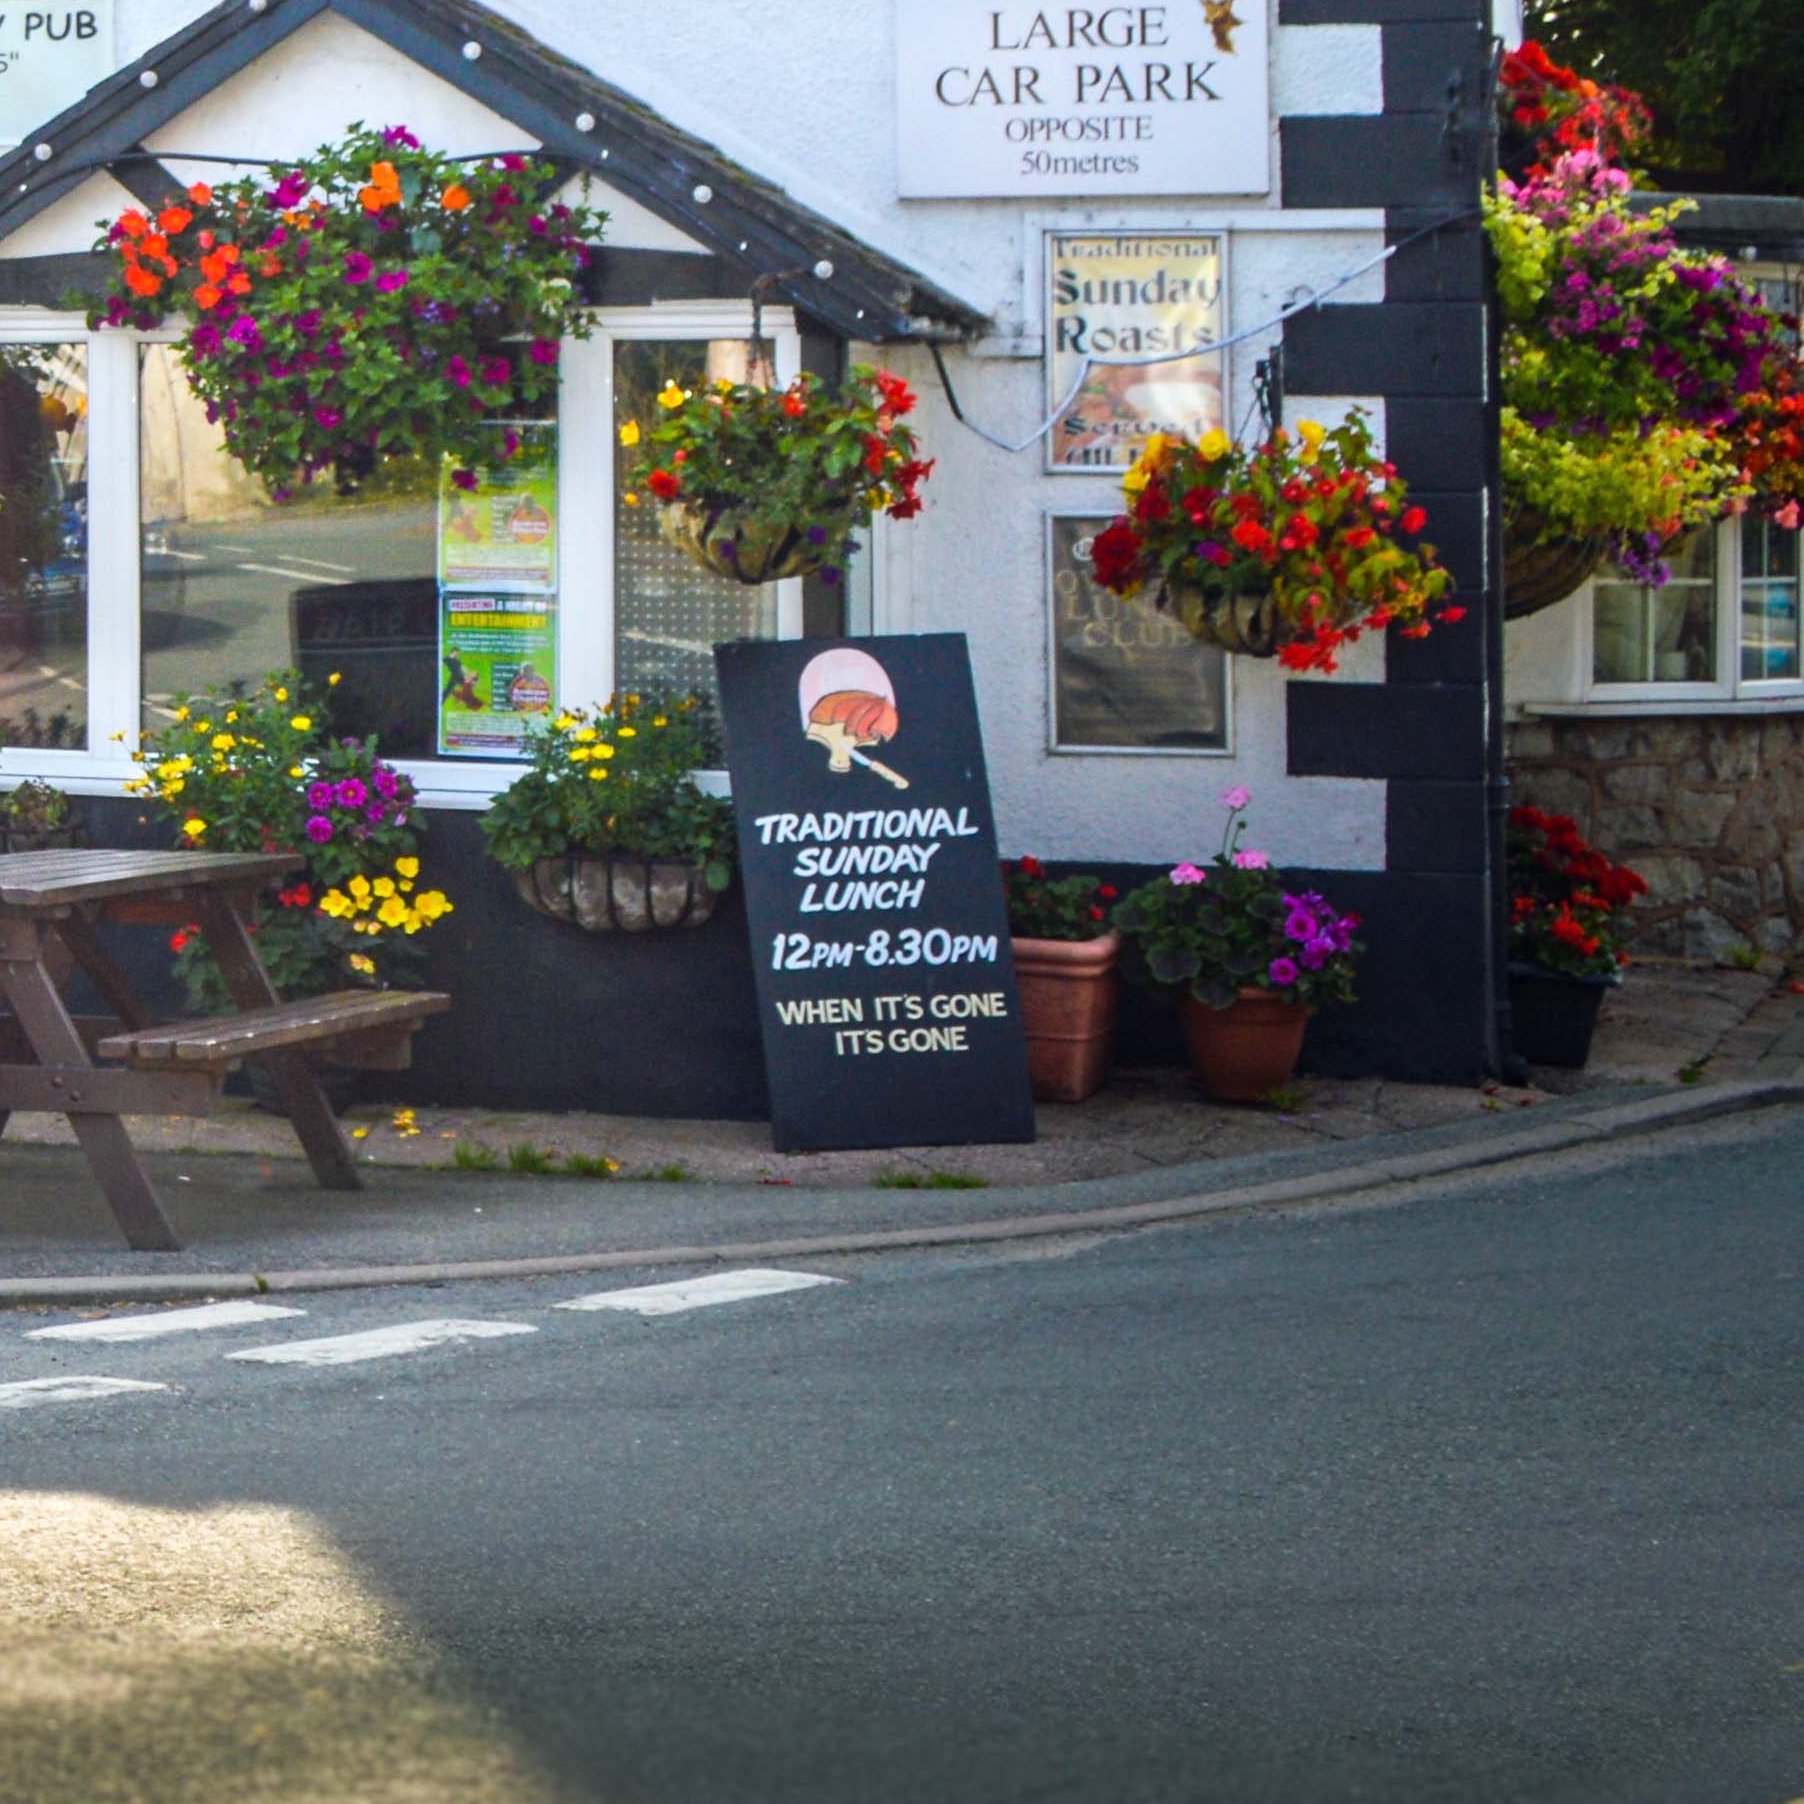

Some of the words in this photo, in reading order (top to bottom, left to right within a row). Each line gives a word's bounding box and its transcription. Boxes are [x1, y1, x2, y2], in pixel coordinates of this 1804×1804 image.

[24, 11, 98, 41] PUB
[989, 5, 1169, 51] LARGE
[935, 65, 1045, 107] CAR
[1075, 60, 1223, 104] PARK
[1005, 115, 1155, 143] OPPOSITE
[1020, 151, 1140, 176] 50metres
[1055, 236, 1219, 259] Traditional
[1054, 267, 1222, 309] Sunday
[1055, 315, 1215, 354] Roasts
[755, 807, 979, 845] TRADITIONAL
[794, 842, 940, 877] SUNDAY
[799, 879, 925, 914] LUNCH
[776, 997, 863, 1026] WHEN
[874, 994, 924, 1021] IT'S
[930, 992, 1007, 1019] GONE
[835, 1028, 884, 1056] IT'S
[888, 1026, 969, 1053] GONE
